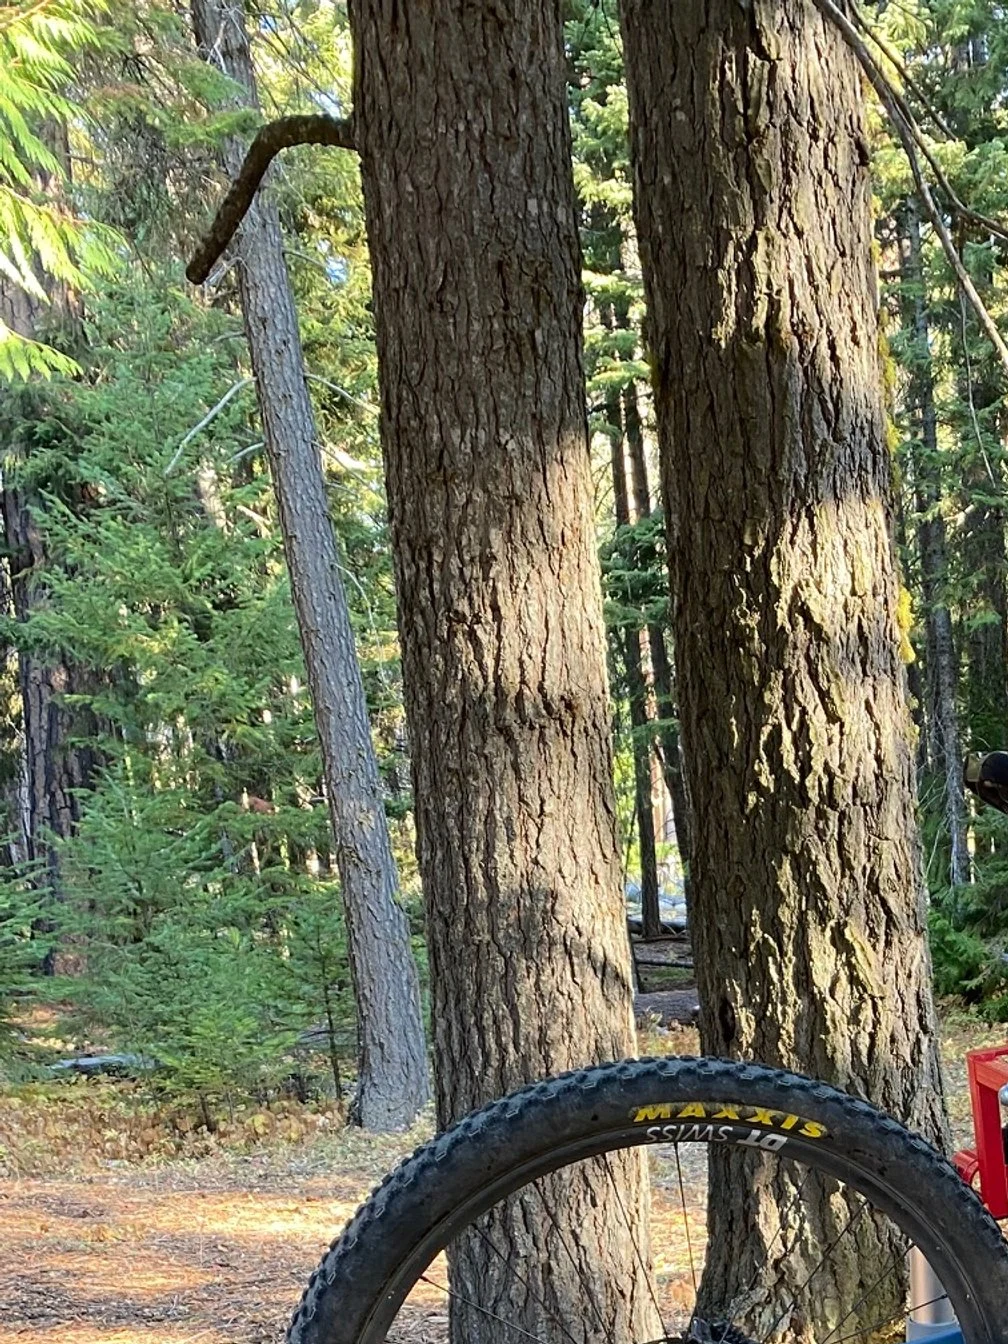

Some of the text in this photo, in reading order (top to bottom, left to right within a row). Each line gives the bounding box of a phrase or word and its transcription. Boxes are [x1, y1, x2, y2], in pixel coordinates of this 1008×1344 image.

[631, 1103, 829, 1139] MAXXIS
[646, 1125, 789, 1153] DT SWISS
